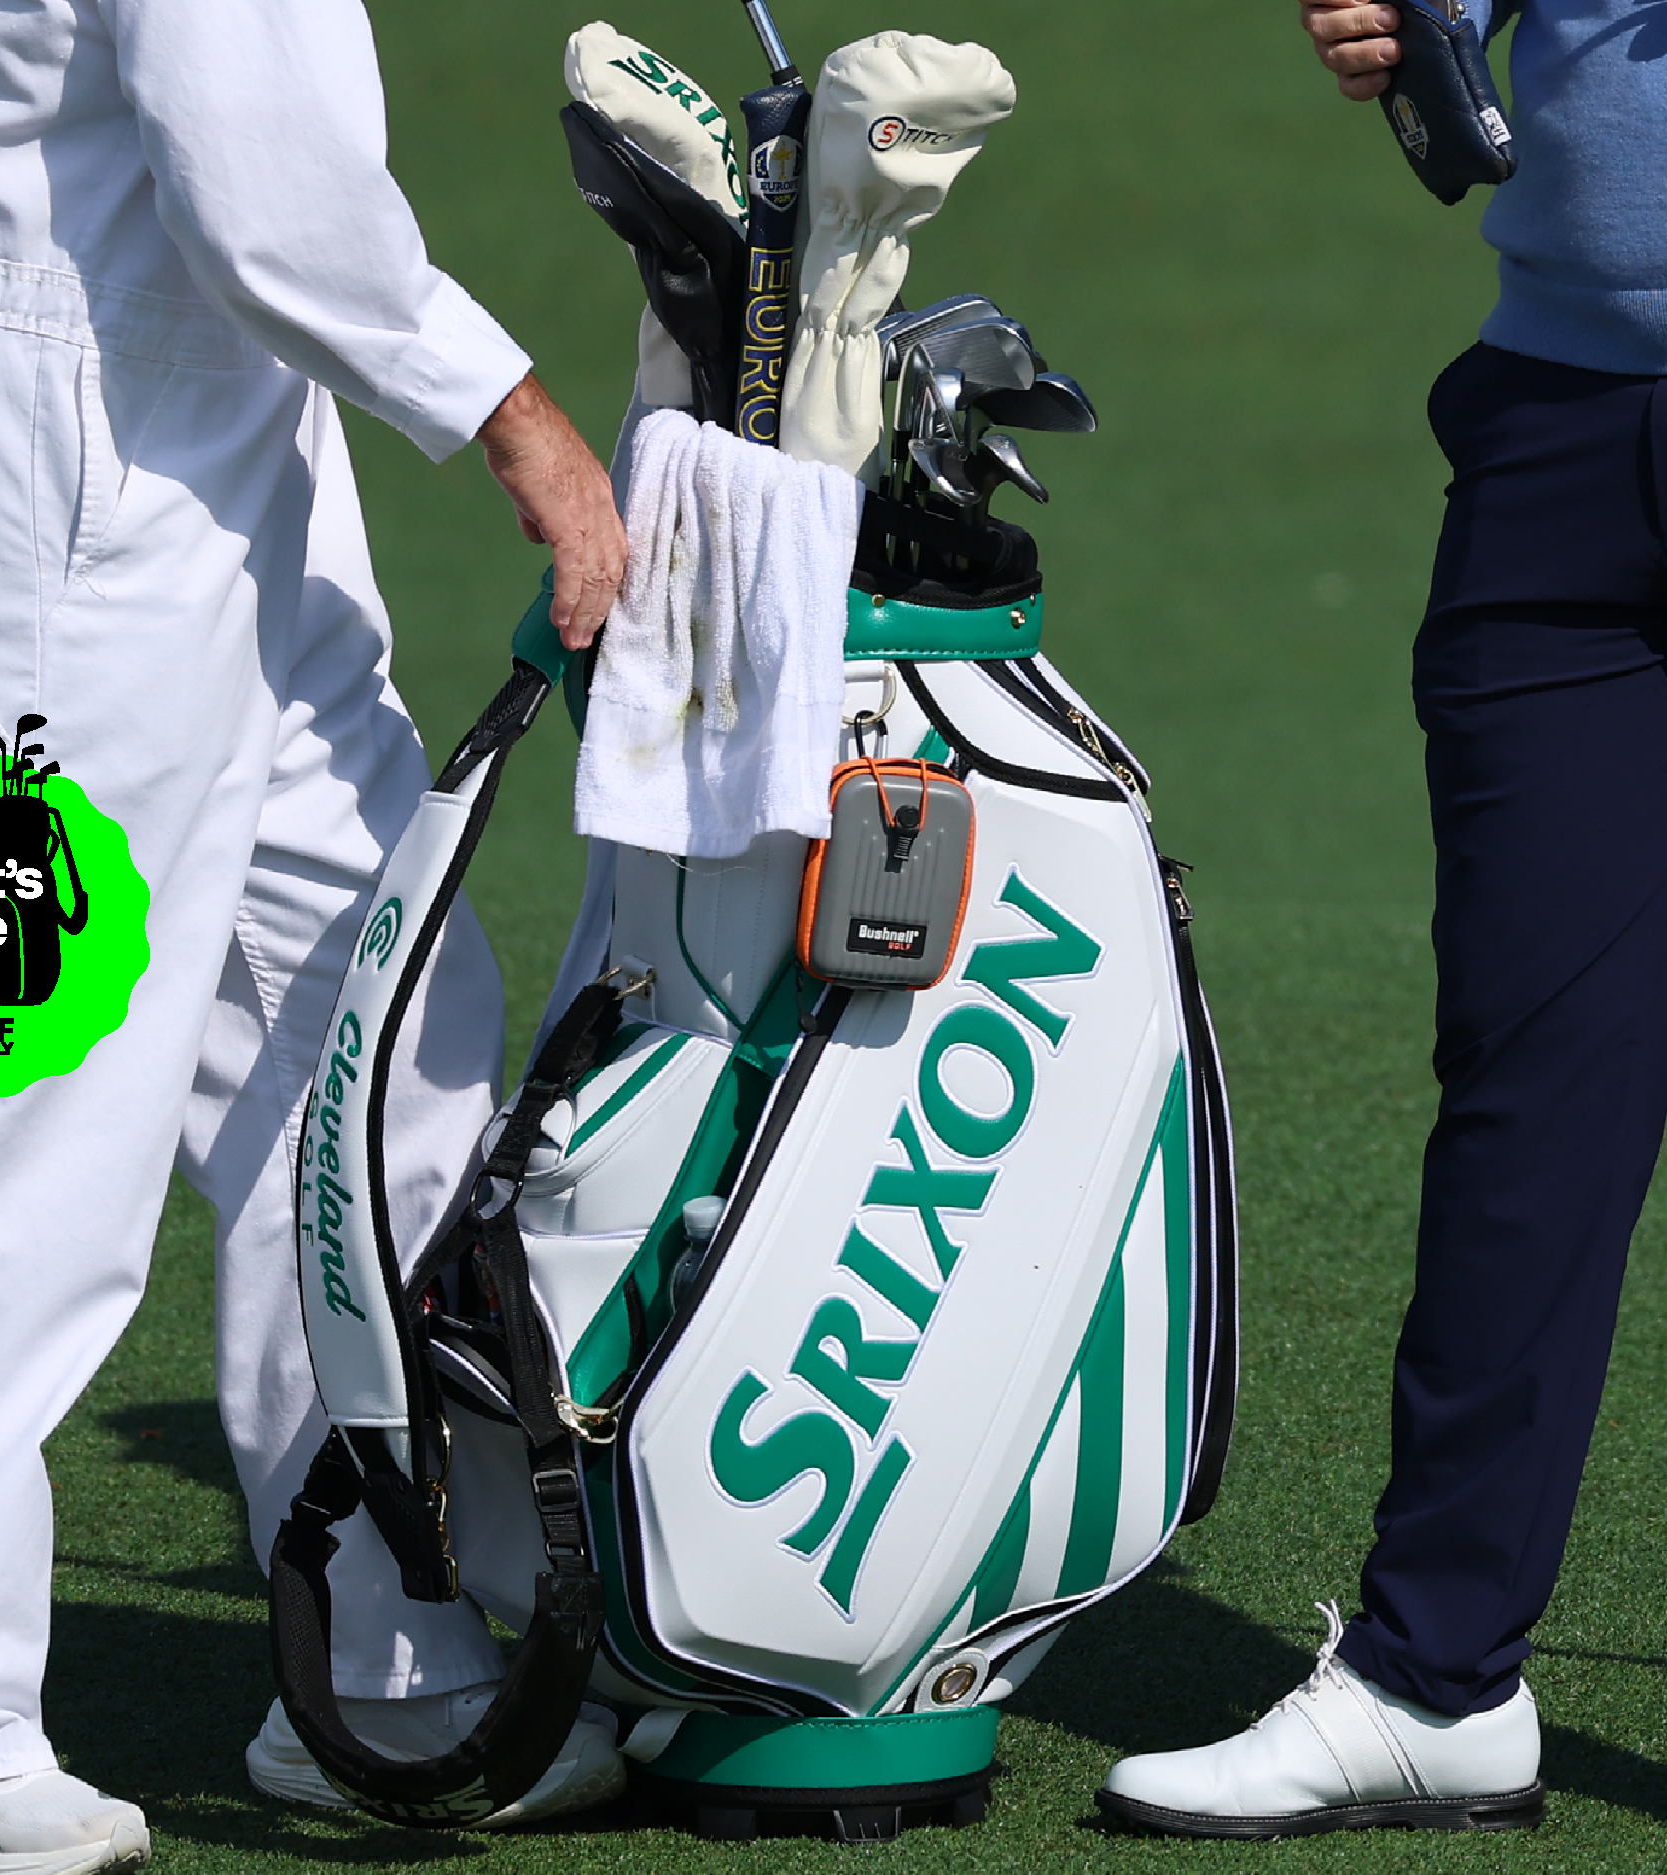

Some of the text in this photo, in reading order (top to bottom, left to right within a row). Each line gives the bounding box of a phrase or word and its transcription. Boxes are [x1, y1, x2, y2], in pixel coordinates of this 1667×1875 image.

[607, 52, 750, 223] SRIXO
[318, 1010, 366, 1323] Cleveland
[707, 865, 1104, 1621] SRIXON
[324, 1769, 494, 1820] SRIX
